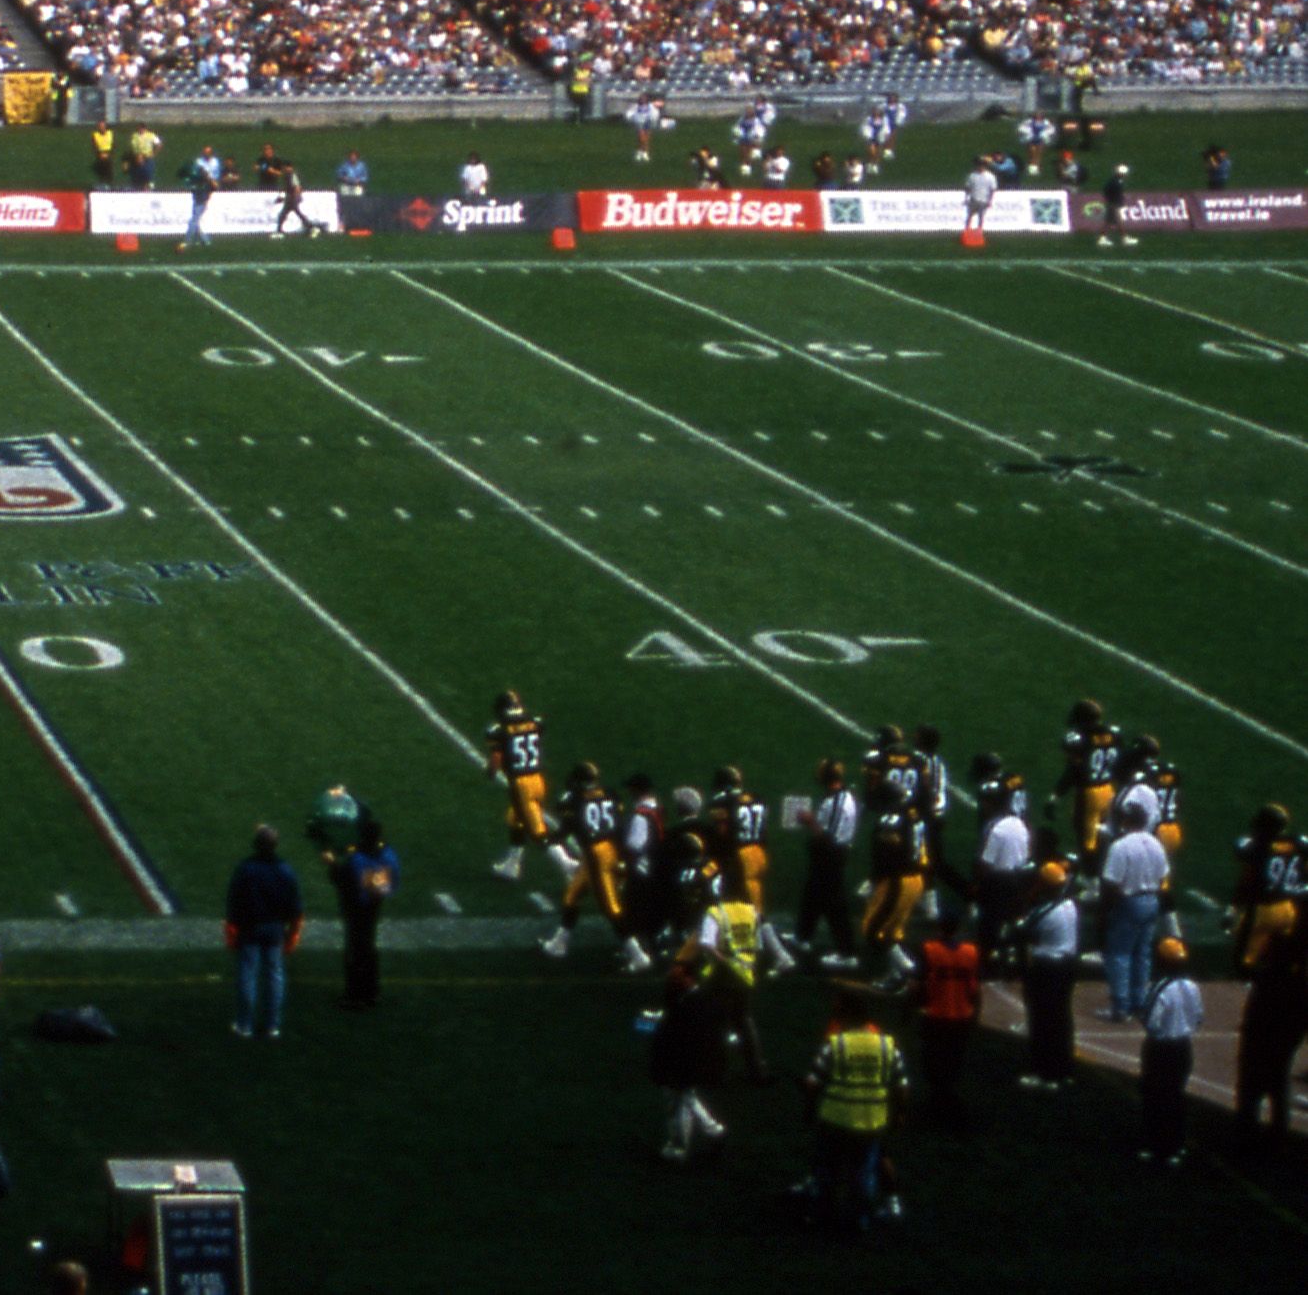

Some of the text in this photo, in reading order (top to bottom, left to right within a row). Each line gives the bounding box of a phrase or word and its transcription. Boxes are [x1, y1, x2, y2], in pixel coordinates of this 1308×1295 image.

[443, 198, 525, 227] Sprint
[602, 192, 802, 228] Budweiser
[1120, 199, 1189, 222] reland
[511, 734, 541, 770] 55
[584, 799, 616, 836] 95
[736, 804, 765, 841] 37
